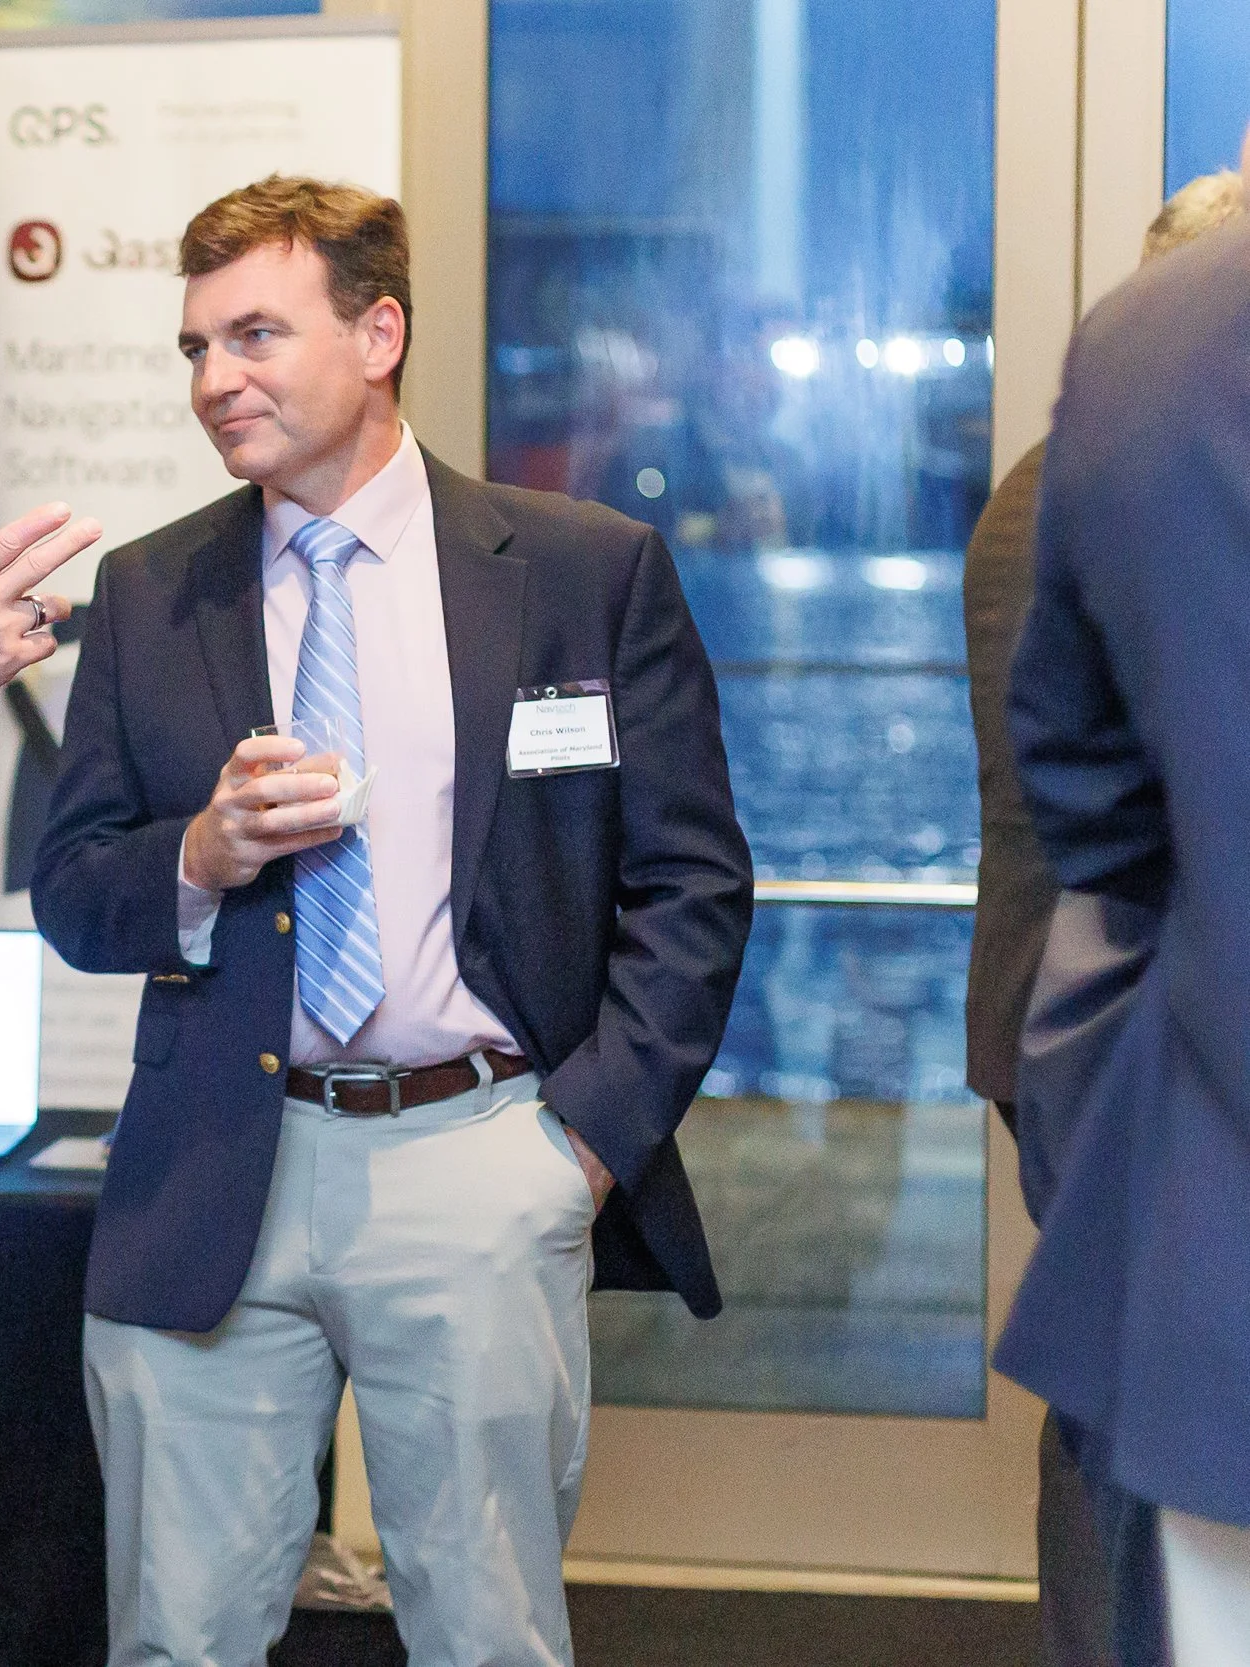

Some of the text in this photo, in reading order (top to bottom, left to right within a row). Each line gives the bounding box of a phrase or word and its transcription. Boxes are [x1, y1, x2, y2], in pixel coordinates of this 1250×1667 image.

[4, 336, 173, 377] Maritime
[4, 448, 180, 493] Software
[530, 726, 586, 737] Chris Wilson
[518, 748, 558, 756] Association
[569, 743, 603, 753] Maryland
